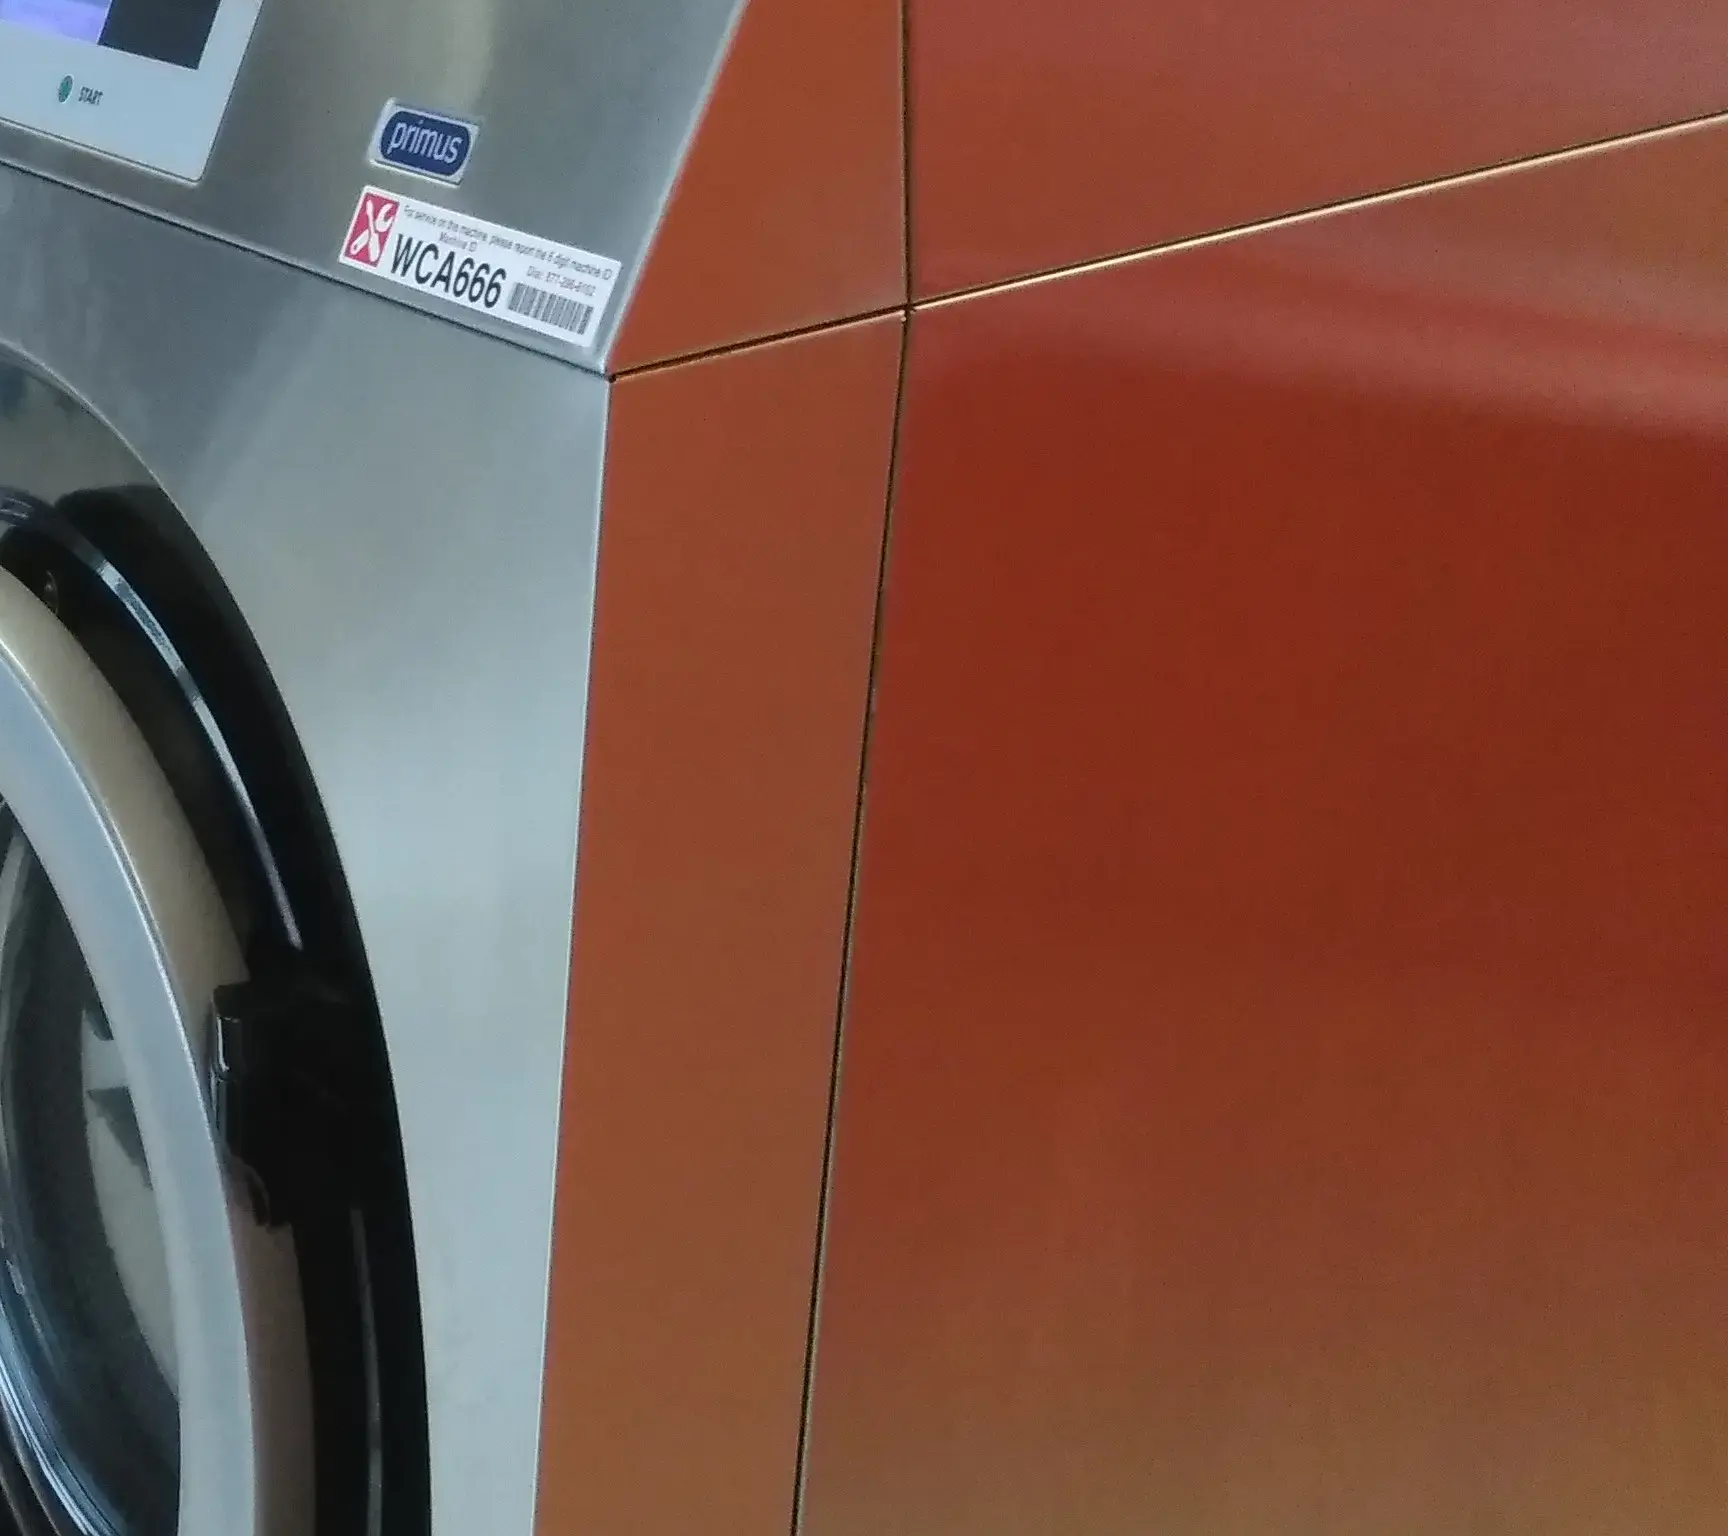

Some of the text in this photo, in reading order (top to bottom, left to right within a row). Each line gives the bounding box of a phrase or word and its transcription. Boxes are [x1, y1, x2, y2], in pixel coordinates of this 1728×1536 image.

[78, 86, 104, 105] START
[387, 120, 463, 164] primus
[391, 233, 507, 308] WCA666
